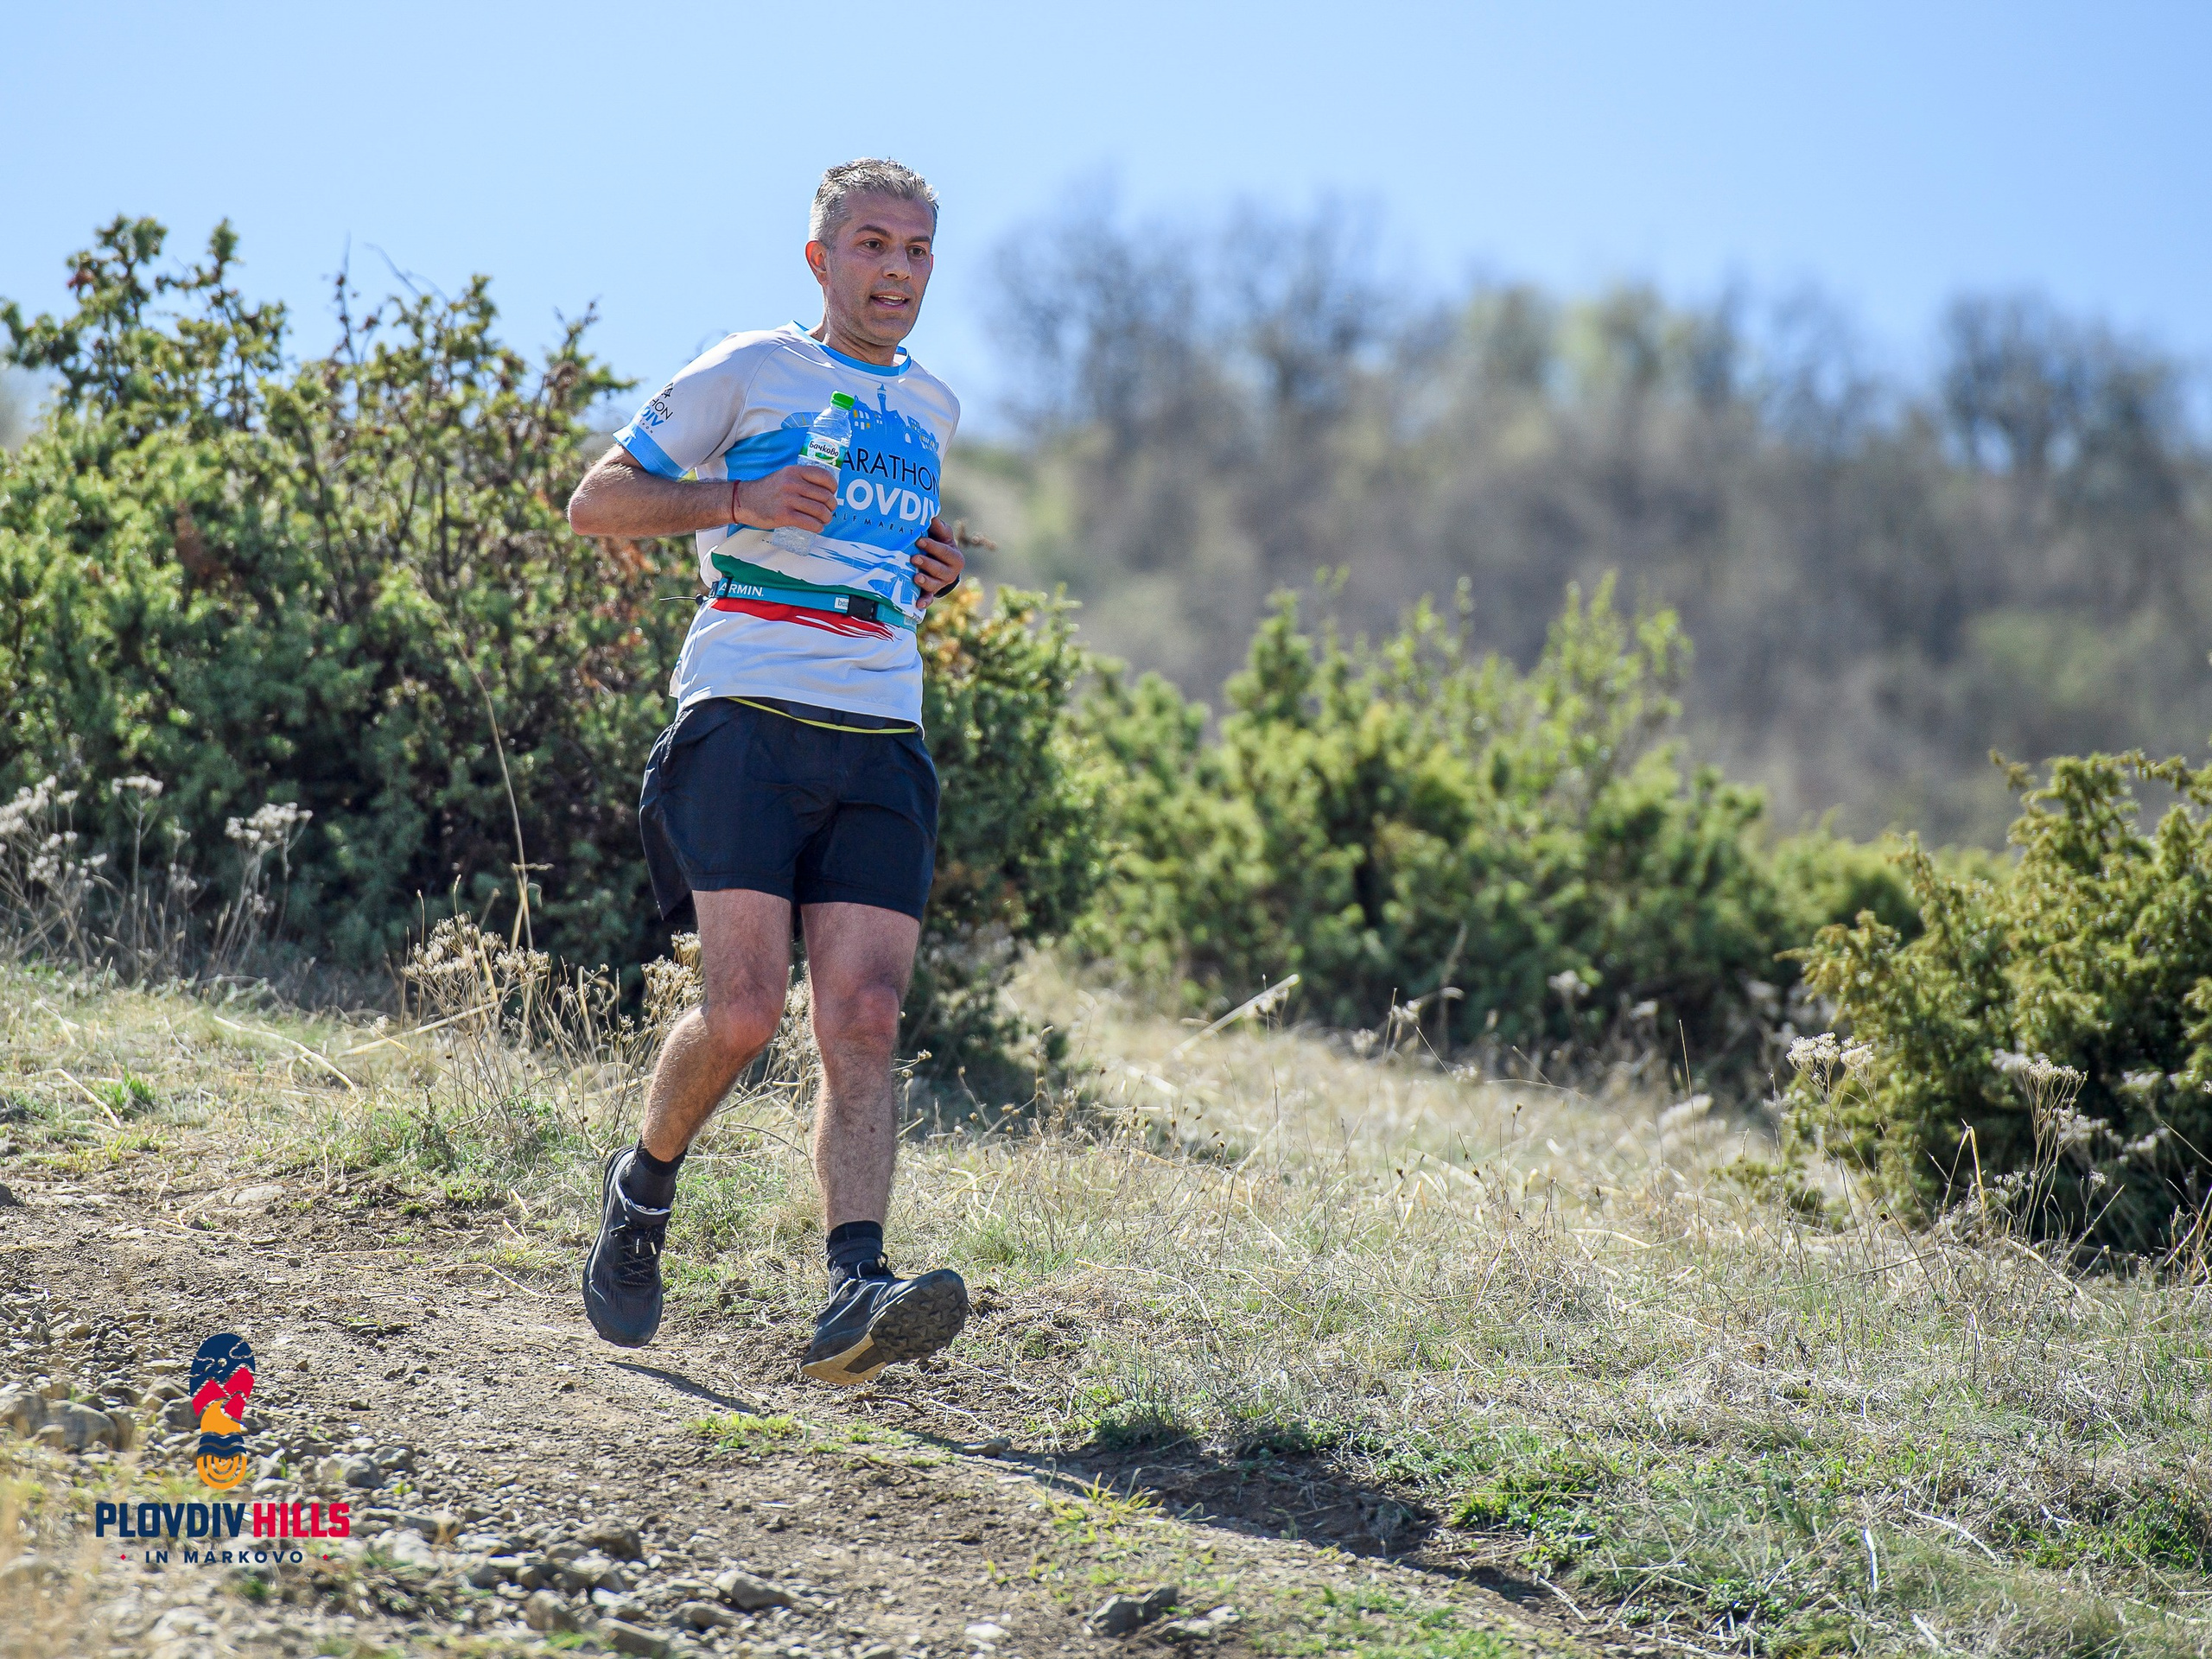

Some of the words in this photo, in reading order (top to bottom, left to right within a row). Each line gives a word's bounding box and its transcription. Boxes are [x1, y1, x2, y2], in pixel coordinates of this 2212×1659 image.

[809, 441, 839, 457] Бачково
[843, 448, 940, 496] ARATHON
[832, 512, 856, 522] ALF
[864, 518, 925, 535] MARAT
